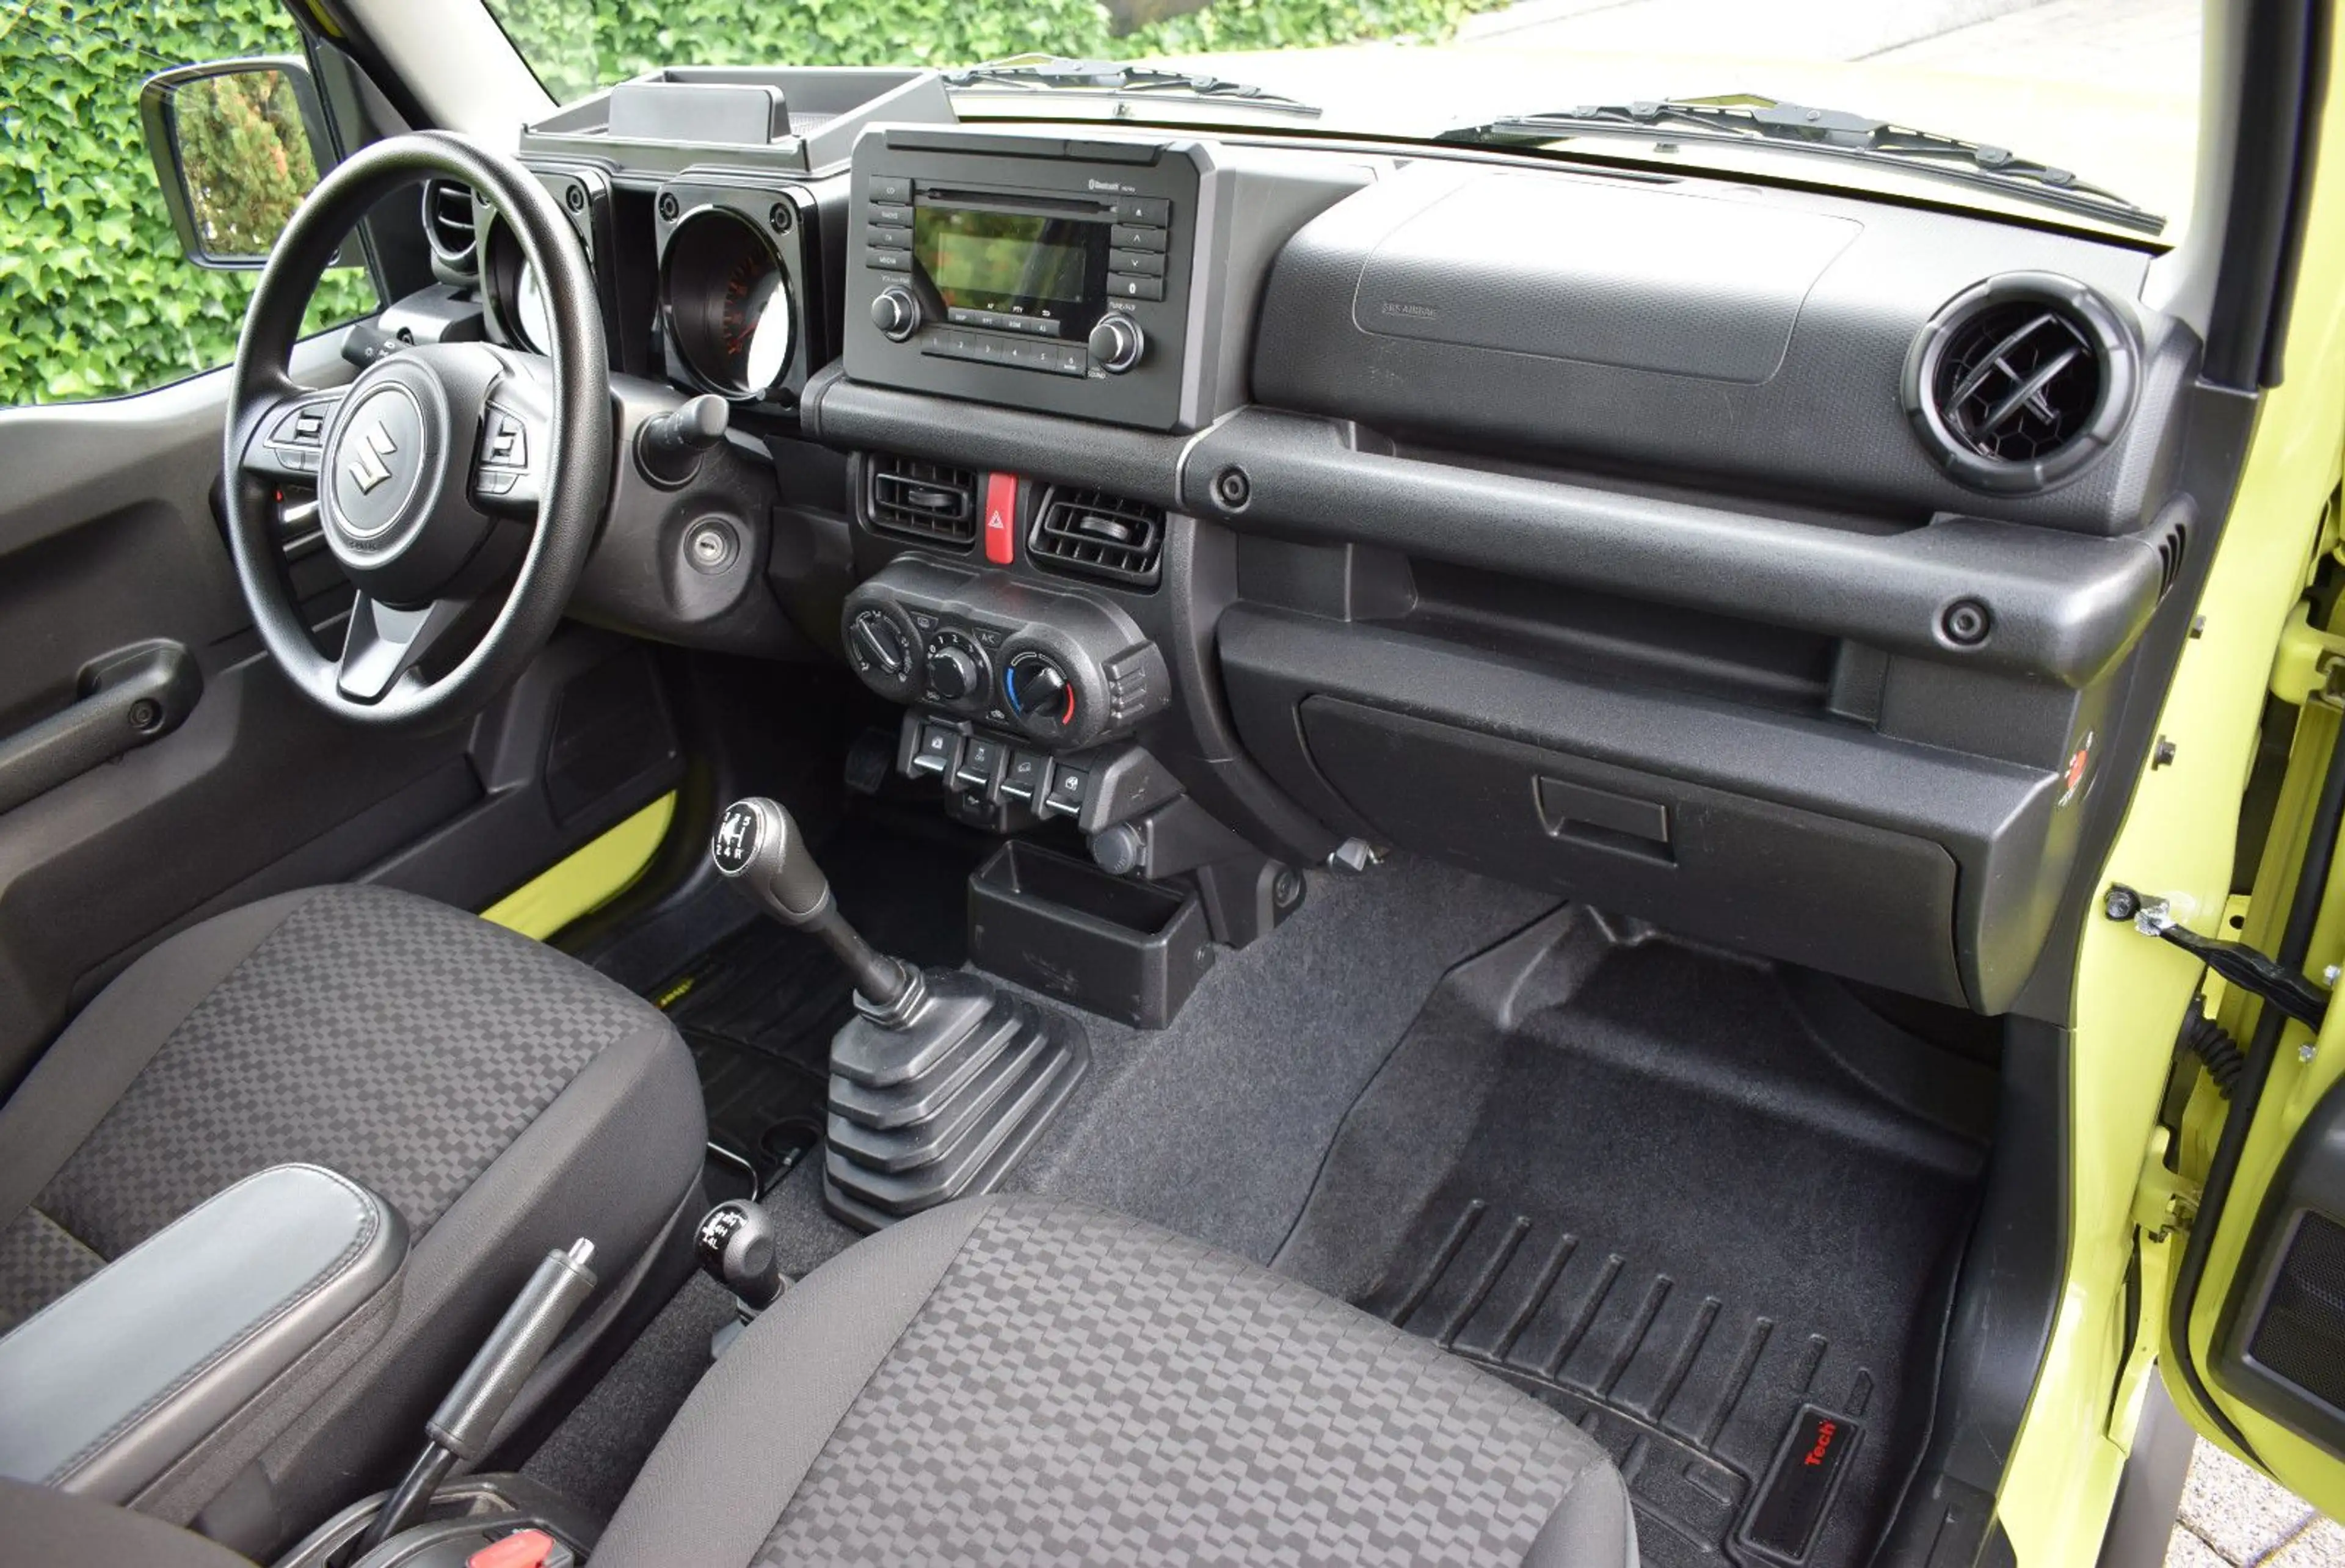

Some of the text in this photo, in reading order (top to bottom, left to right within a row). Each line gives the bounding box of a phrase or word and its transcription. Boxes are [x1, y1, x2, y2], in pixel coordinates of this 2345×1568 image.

[938, 636, 943, 644] 1
[953, 634, 958, 643] 2
[724, 811, 731, 822] 1
[743, 816, 751, 827] 5
[716, 844, 742, 860] 2 4 R
[1804, 1420, 1836, 1465] Tech
